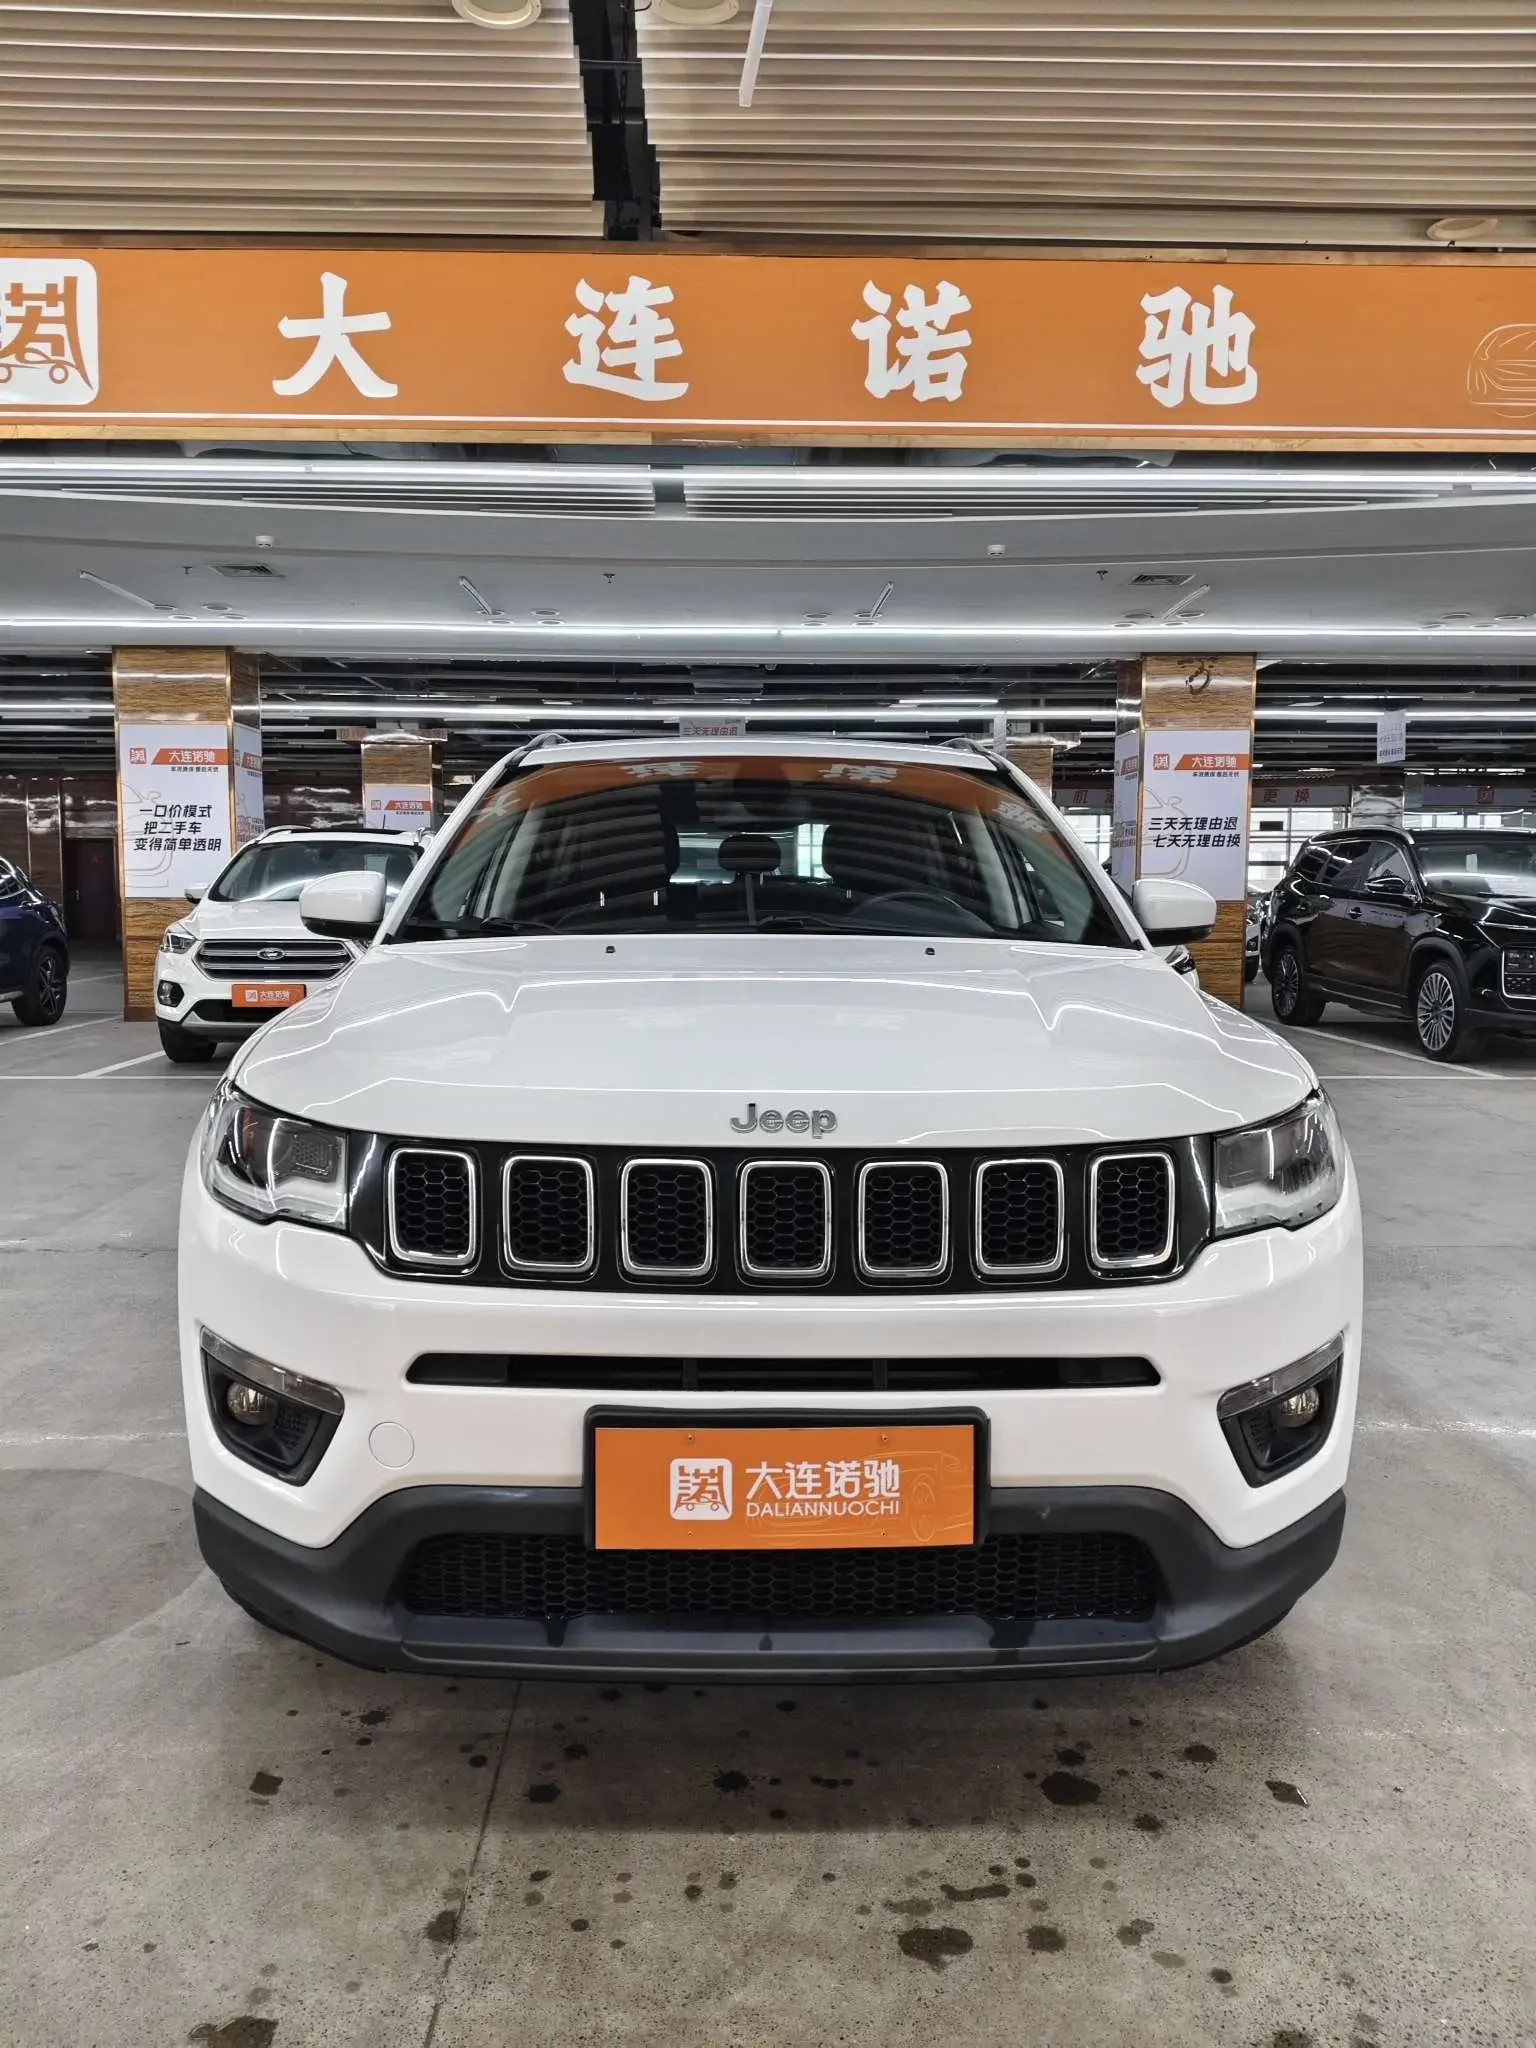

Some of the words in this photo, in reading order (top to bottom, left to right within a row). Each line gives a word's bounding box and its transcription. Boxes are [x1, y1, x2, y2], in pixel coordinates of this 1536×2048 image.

[271, 271, 1259, 409] 大连诺驰
[168, 750, 216, 763] 大连诺驰
[1191, 756, 1237, 768] 大连诺驰
[1262, 788, 1310, 803] 更换
[139, 804, 212, 819] 一口价模式
[143, 820, 203, 835] 把二手车
[1148, 815, 1238, 831] 三天无理由退
[134, 838, 222, 852] 变得简单透明
[1152, 832, 1241, 848] 七天无理由换
[730, 1102, 838, 1140] Jeep
[745, 1459, 901, 1500] 大连诺驰
[746, 1500, 901, 1518] DALIANNUOCHI
